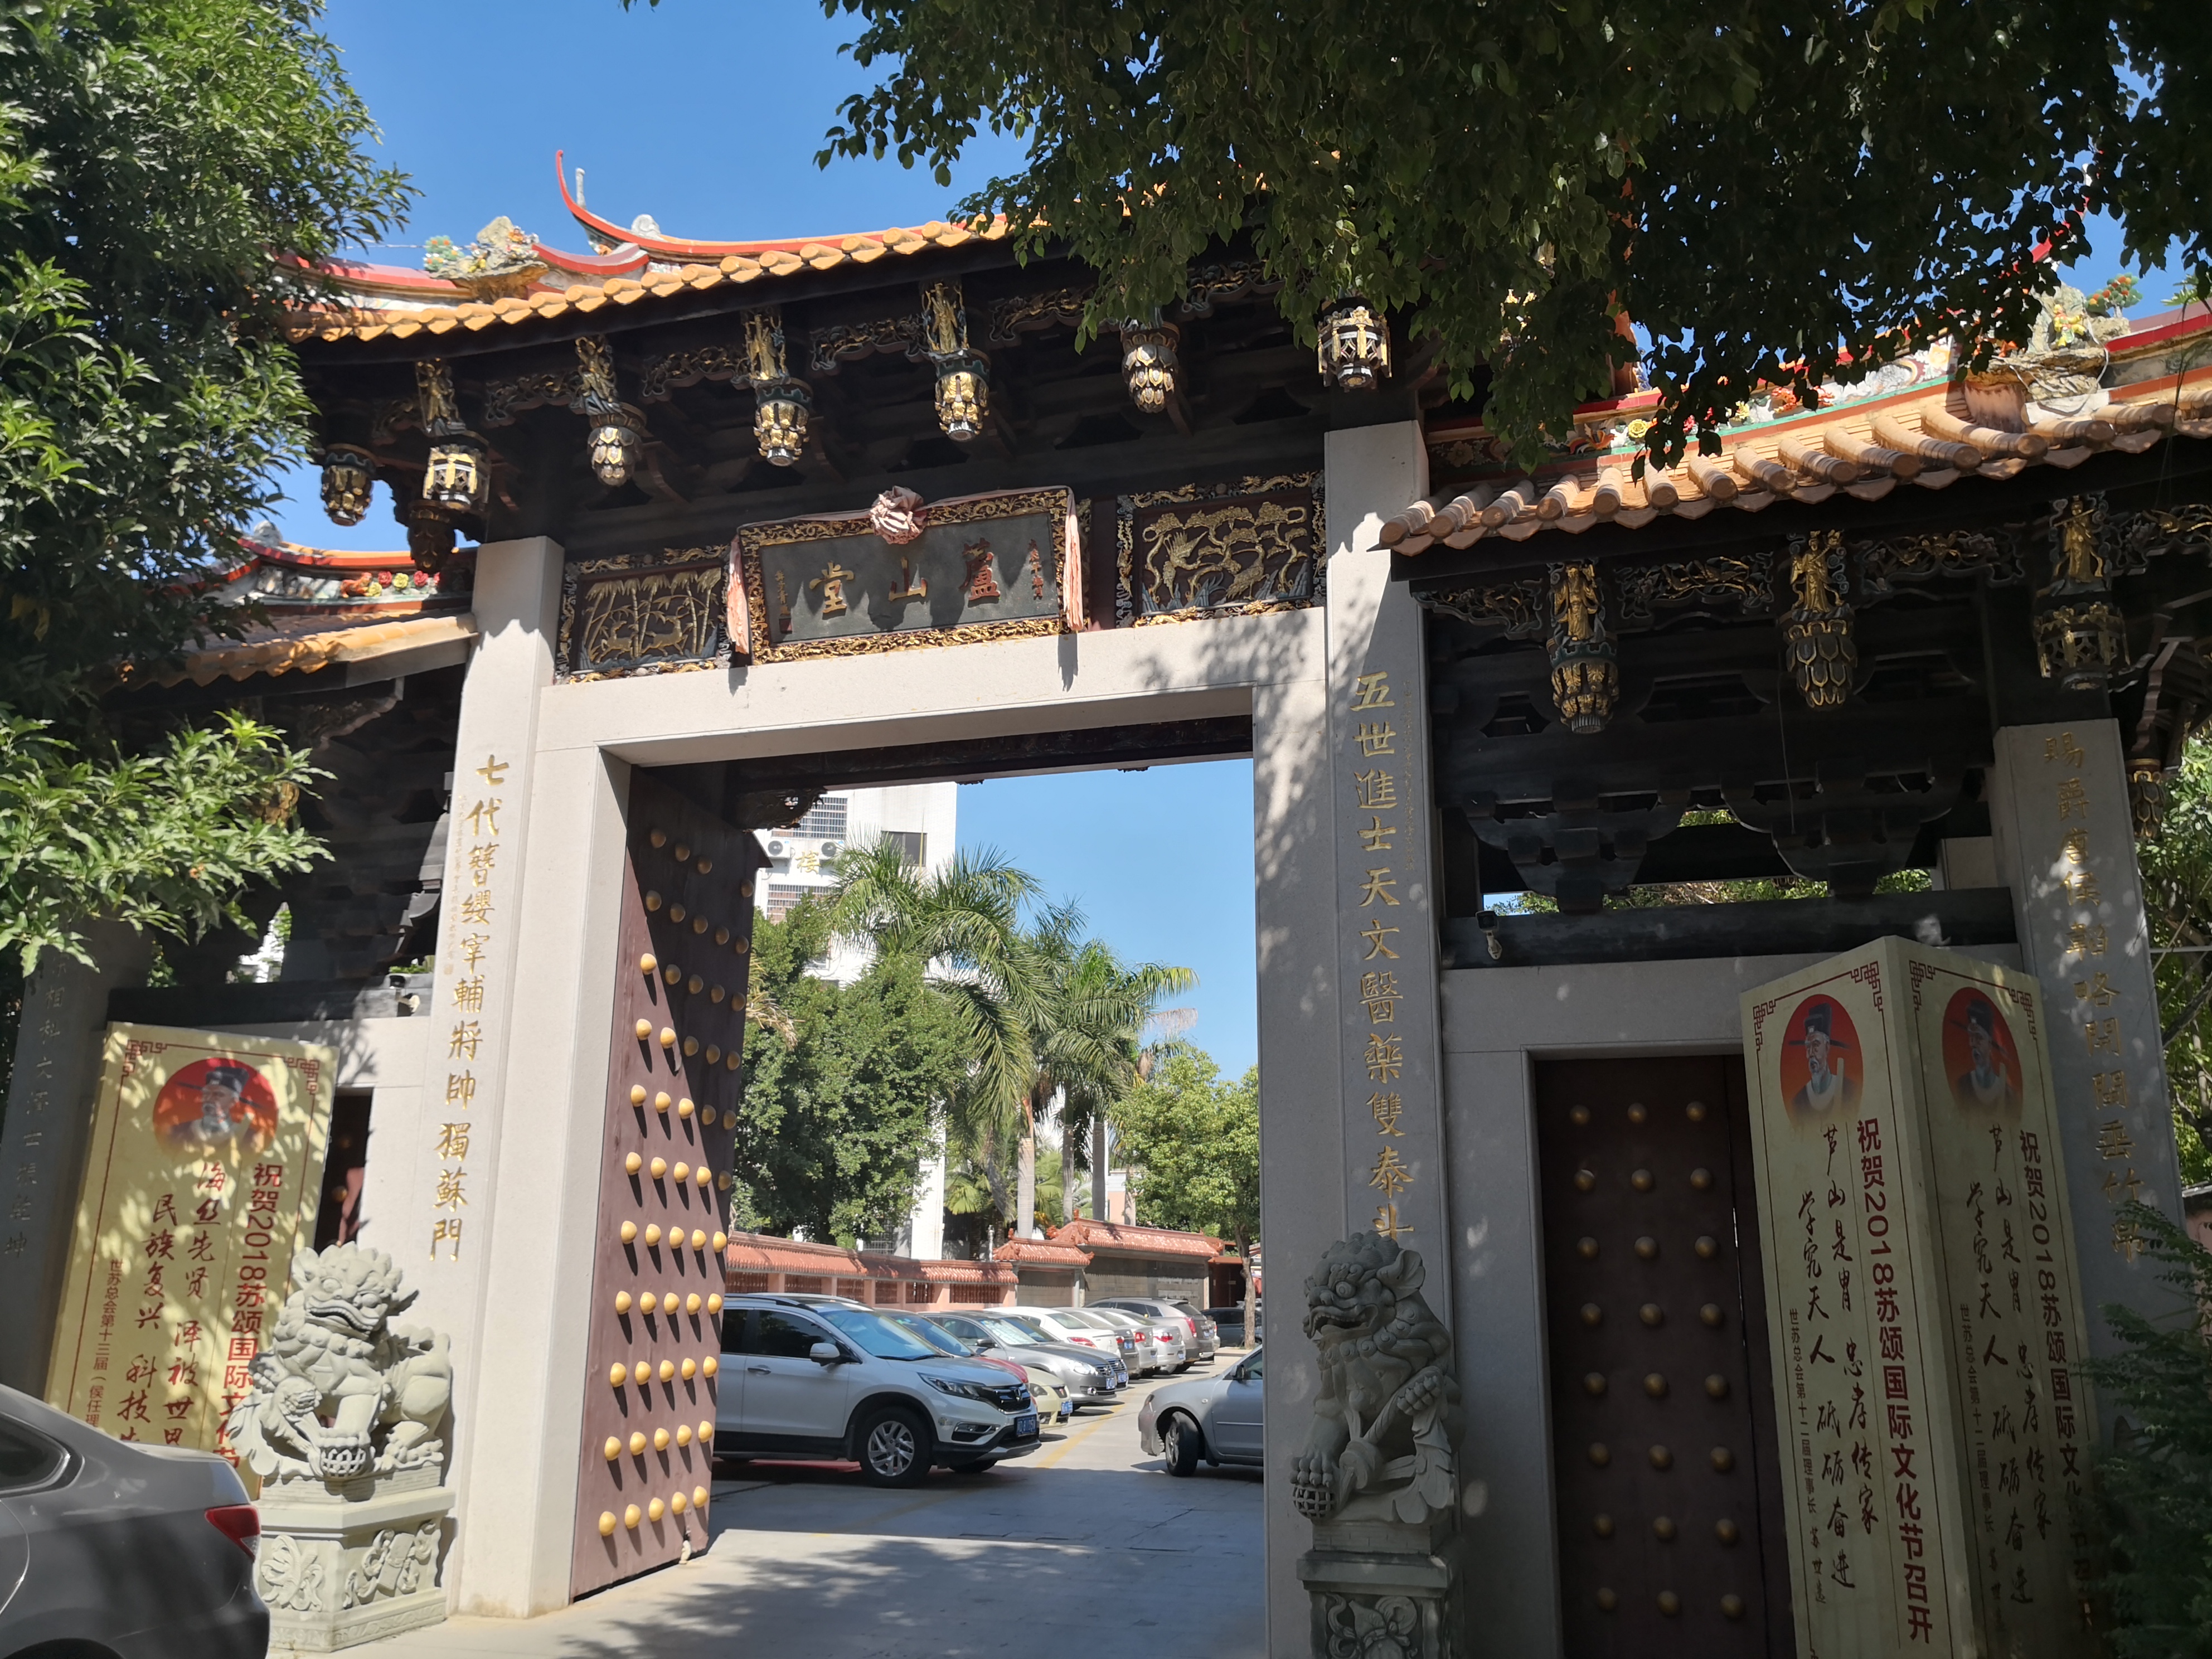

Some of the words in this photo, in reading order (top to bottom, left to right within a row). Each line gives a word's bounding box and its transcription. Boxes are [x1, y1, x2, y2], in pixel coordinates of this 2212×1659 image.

[134, 1193, 177, 1330] 民族复兴
[1857, 1118, 1933, 1644] 祝贺2018苏颂国际文化节召开
[2020, 1130, 2094, 1629] 祝贺2018苏颂国际文
